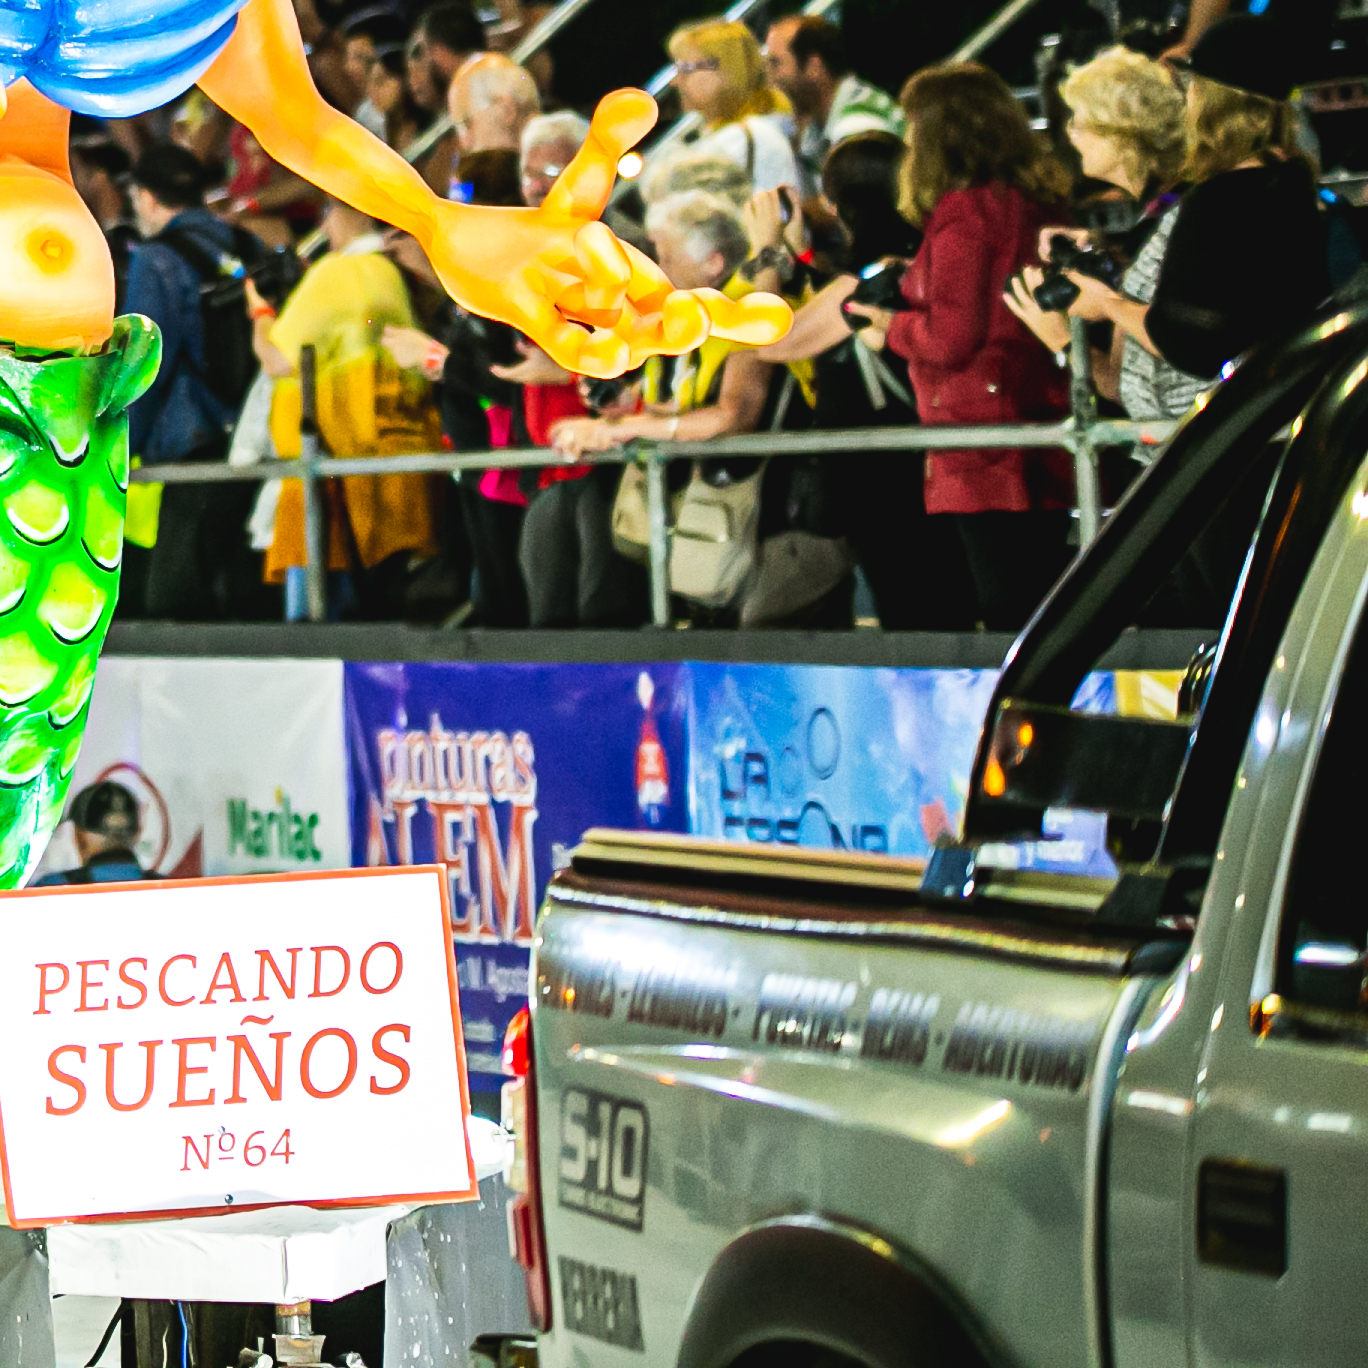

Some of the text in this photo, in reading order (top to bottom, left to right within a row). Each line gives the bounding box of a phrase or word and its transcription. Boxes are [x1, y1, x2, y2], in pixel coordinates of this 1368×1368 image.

[226, 787, 321, 863] Marilac
[33, 941, 403, 1015] PESCANDO
[45, 1015, 411, 1117] SUEÑOS
[561, 1090, 644, 1200] S-10
